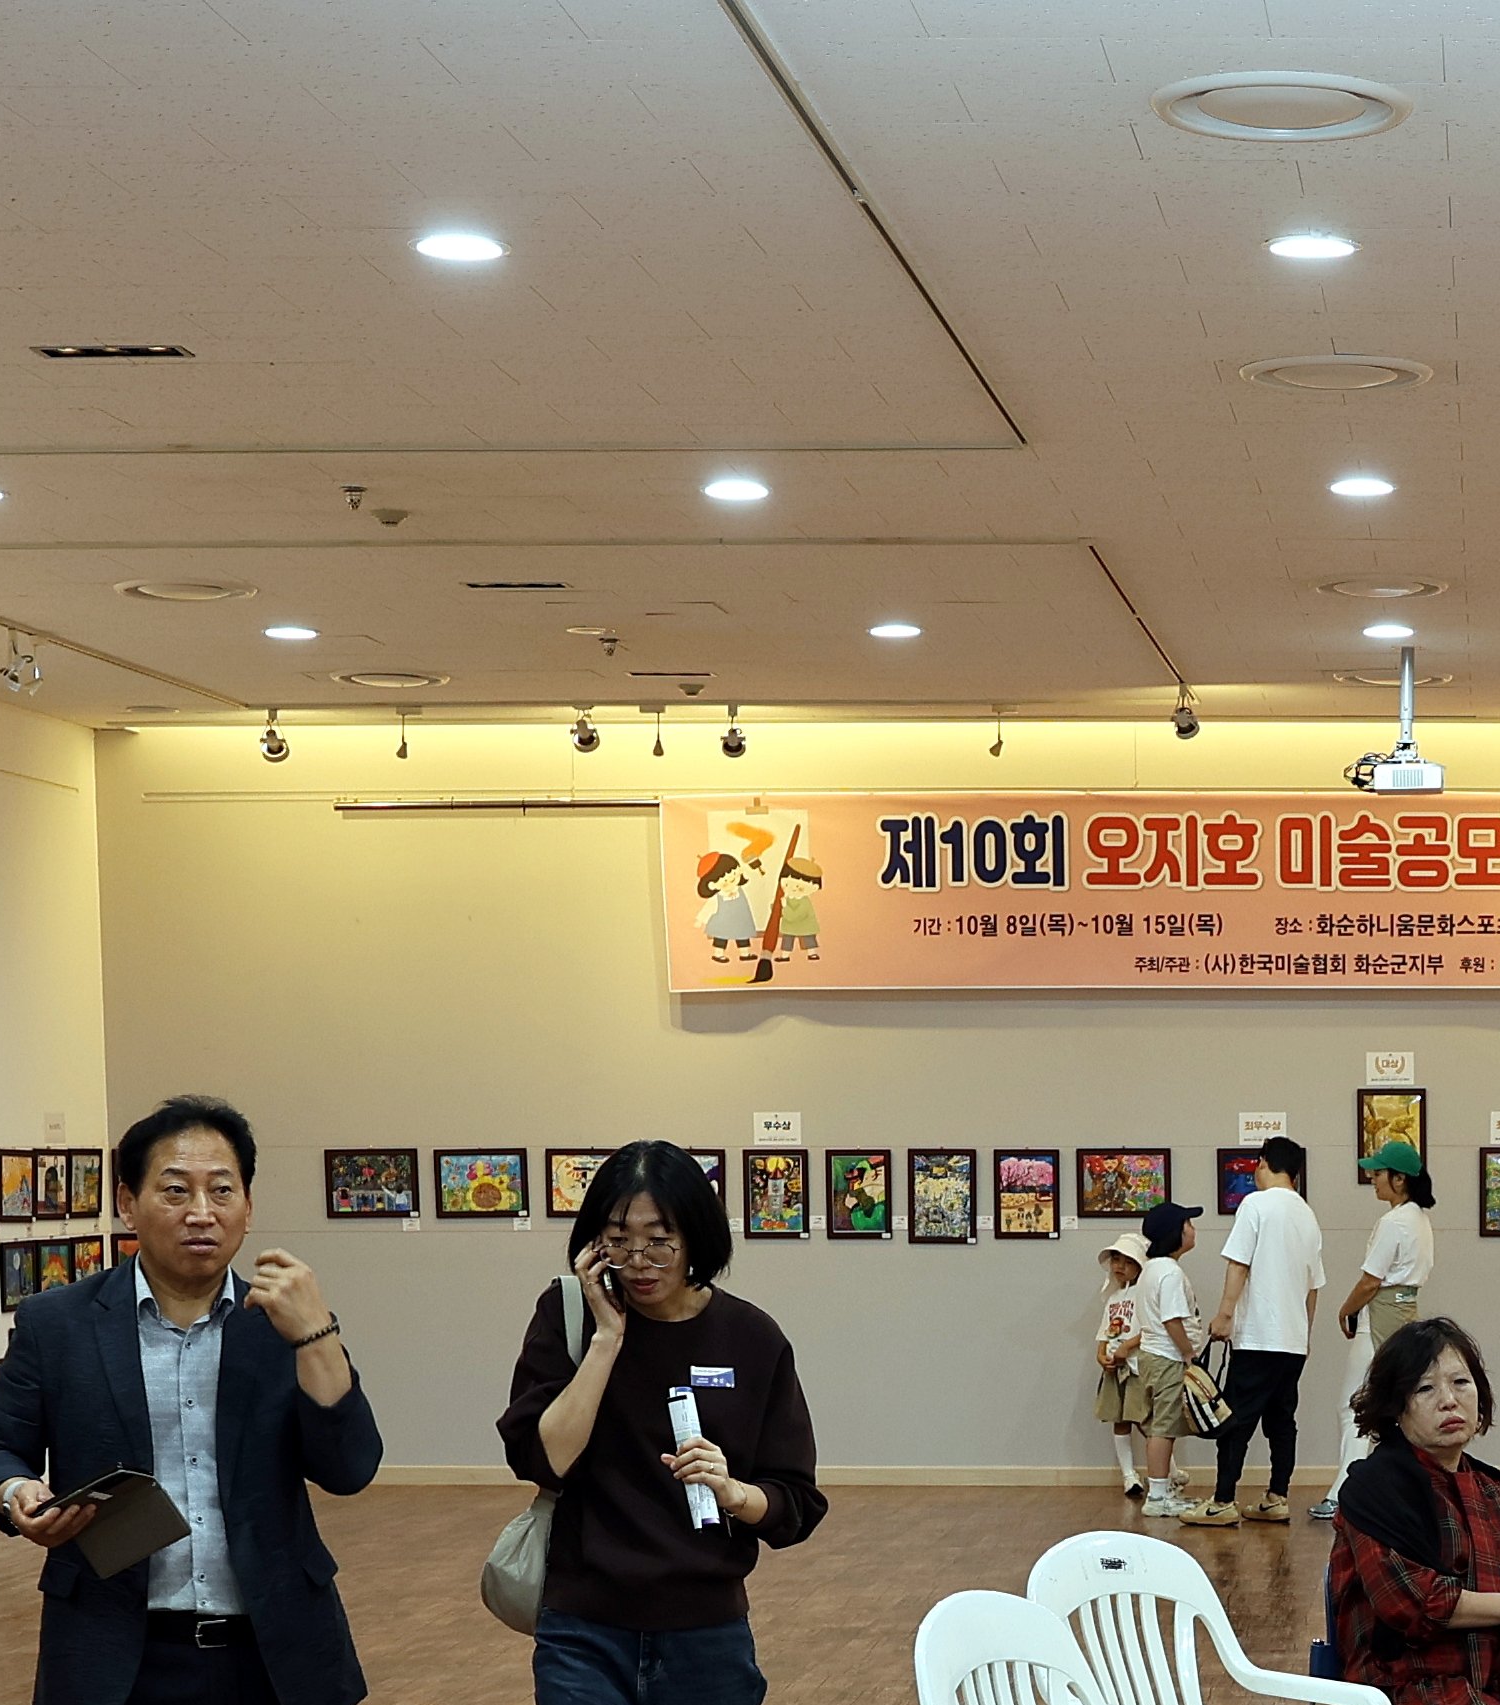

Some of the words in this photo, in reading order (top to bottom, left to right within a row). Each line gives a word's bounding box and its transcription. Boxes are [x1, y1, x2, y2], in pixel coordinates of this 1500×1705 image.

[879, 814, 1065, 889] 제10회
[1085, 811, 1260, 889] 오지호
[913, 917, 942, 936] 기간
[1005, 913, 1134, 938] 8일(목)~10월
[1142, 913, 1224, 938] 15일(목)
[1275, 917, 1303, 937] 장소
[1133, 955, 1191, 974] 주최/주관
[1203, 952, 1347, 976] (사)한국미술협회
[1353, 952, 1446, 976] 화순군지부
[1458, 955, 1486, 974] 후원
[1381, 1059, 1399, 1069] 대상
[763, 1120, 792, 1131] 우수상
[1244, 1120, 1282, 1131] 최우수상
